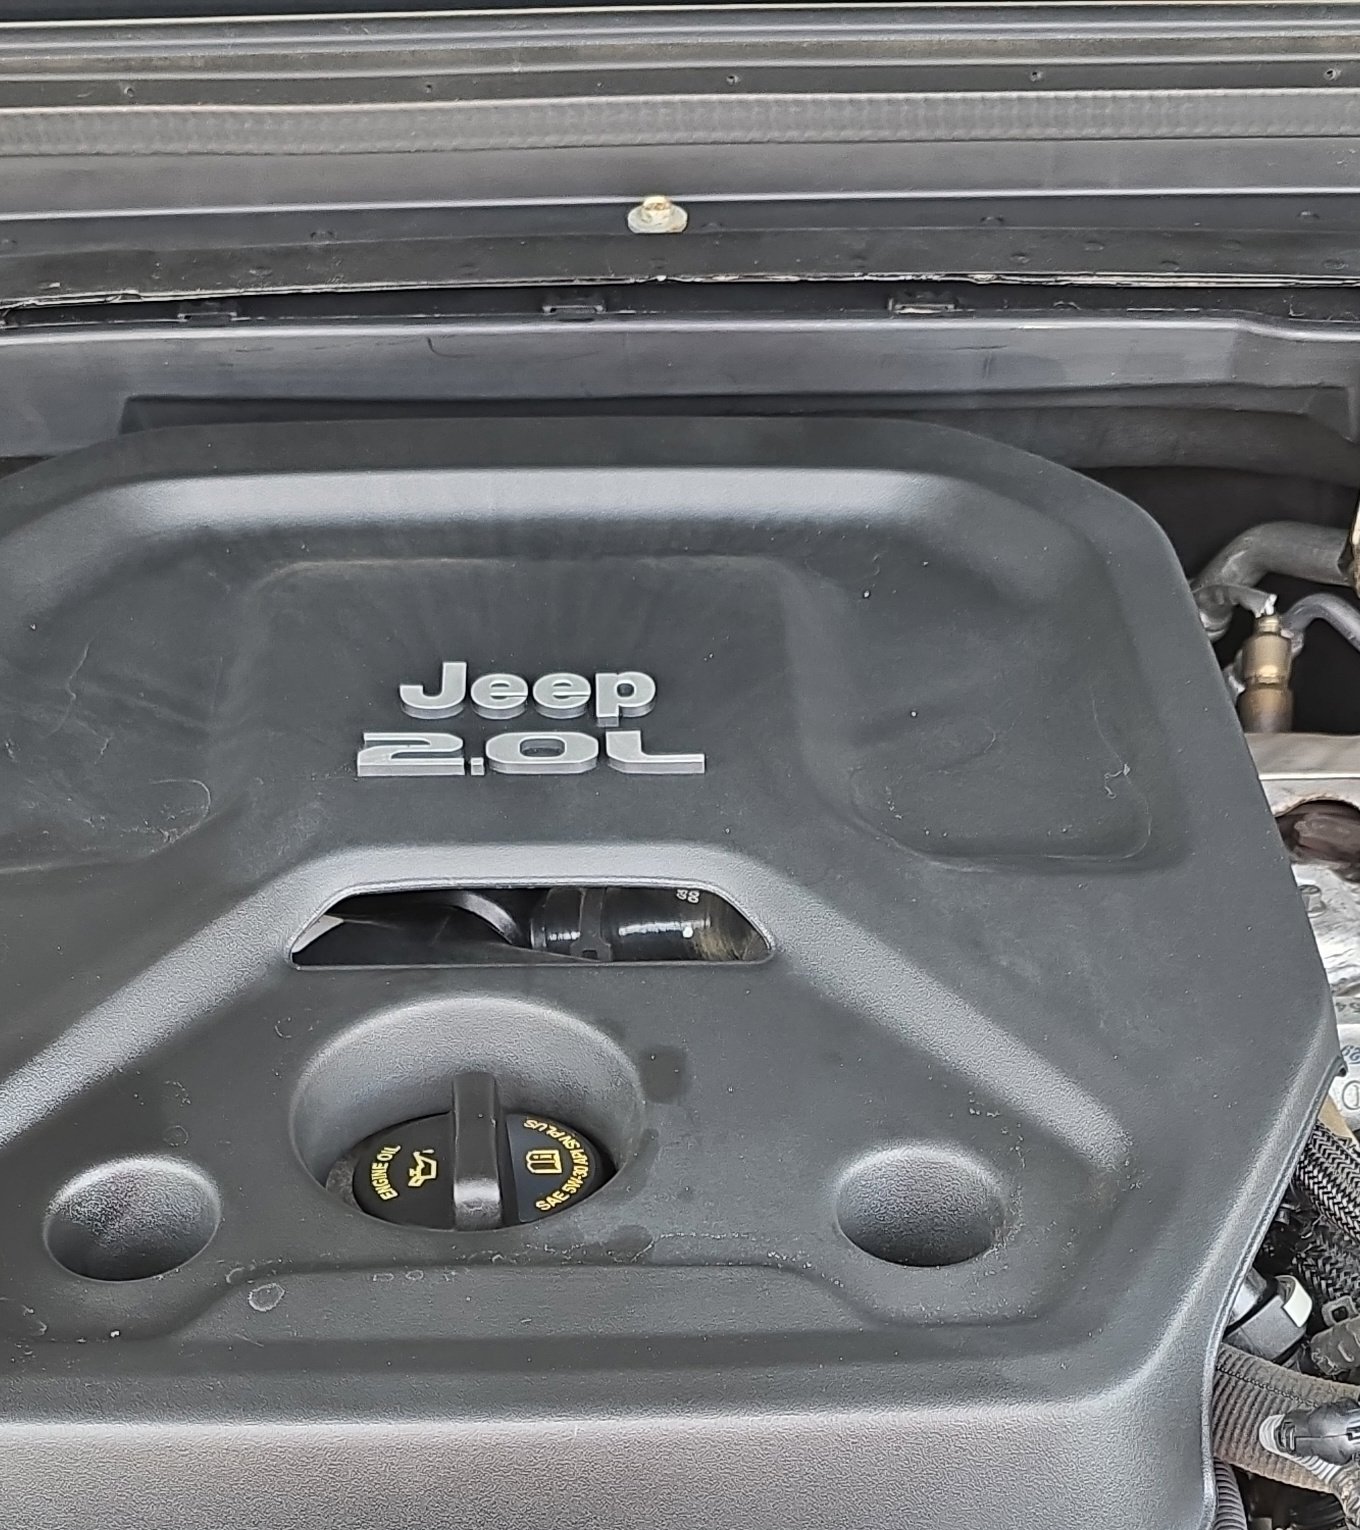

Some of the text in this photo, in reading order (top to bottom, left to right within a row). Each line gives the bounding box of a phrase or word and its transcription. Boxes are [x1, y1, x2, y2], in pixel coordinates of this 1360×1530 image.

[399, 661, 656, 727] Jeep
[357, 730, 705, 776] 2.0L
[369, 1144, 402, 1201] ENGINE OIL
[523, 1118, 590, 1212] SAE 5W-30 API SN PLUS
